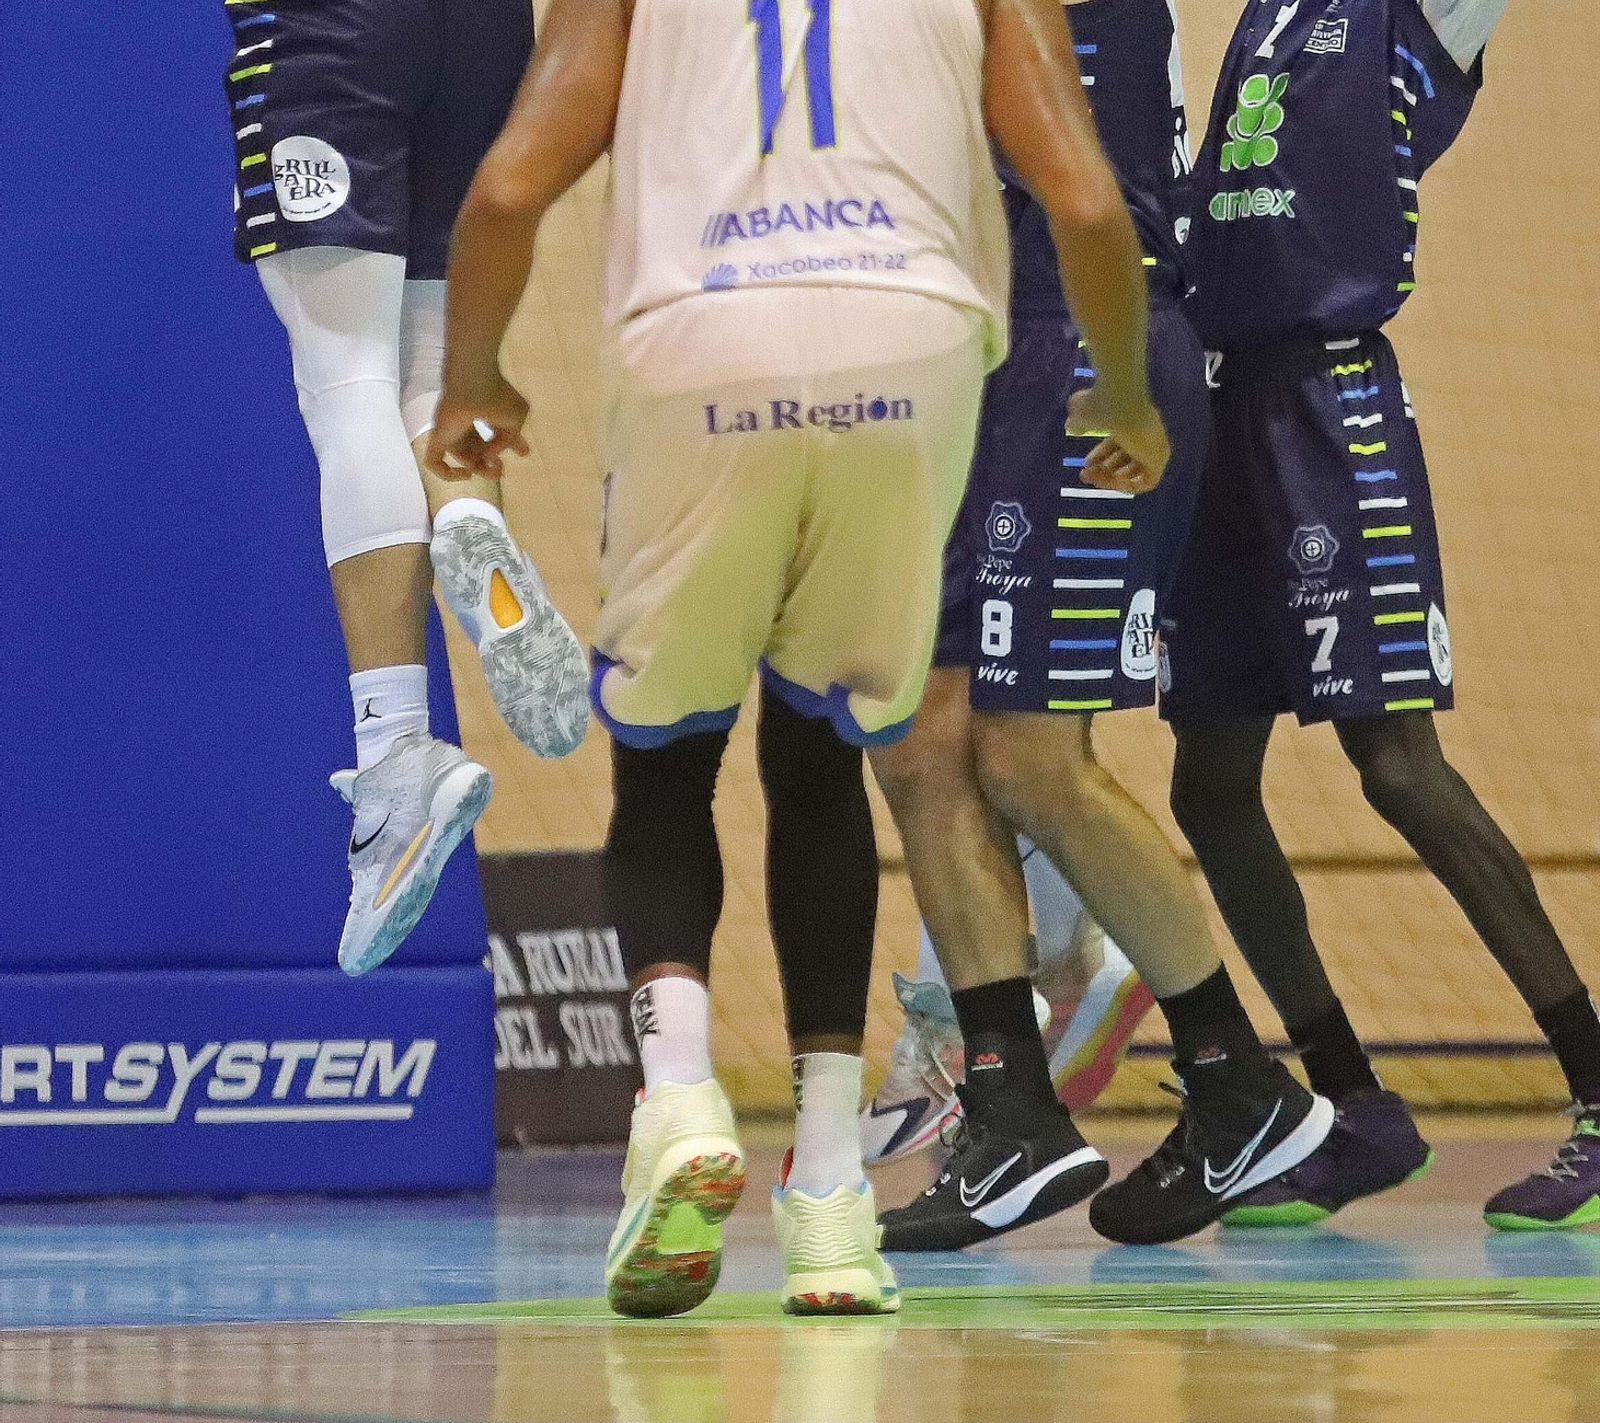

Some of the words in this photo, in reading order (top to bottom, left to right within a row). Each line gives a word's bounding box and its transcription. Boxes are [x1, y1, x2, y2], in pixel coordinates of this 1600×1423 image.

[747, 255, 853, 280] Xacobeo
[703, 404, 758, 434] La
[980, 599, 1014, 657] 8
[1304, 616, 1340, 673] 7
[977, 662, 1019, 686] vive
[1312, 675, 1354, 697] vive
[559, 1000, 633, 1067] SUR
